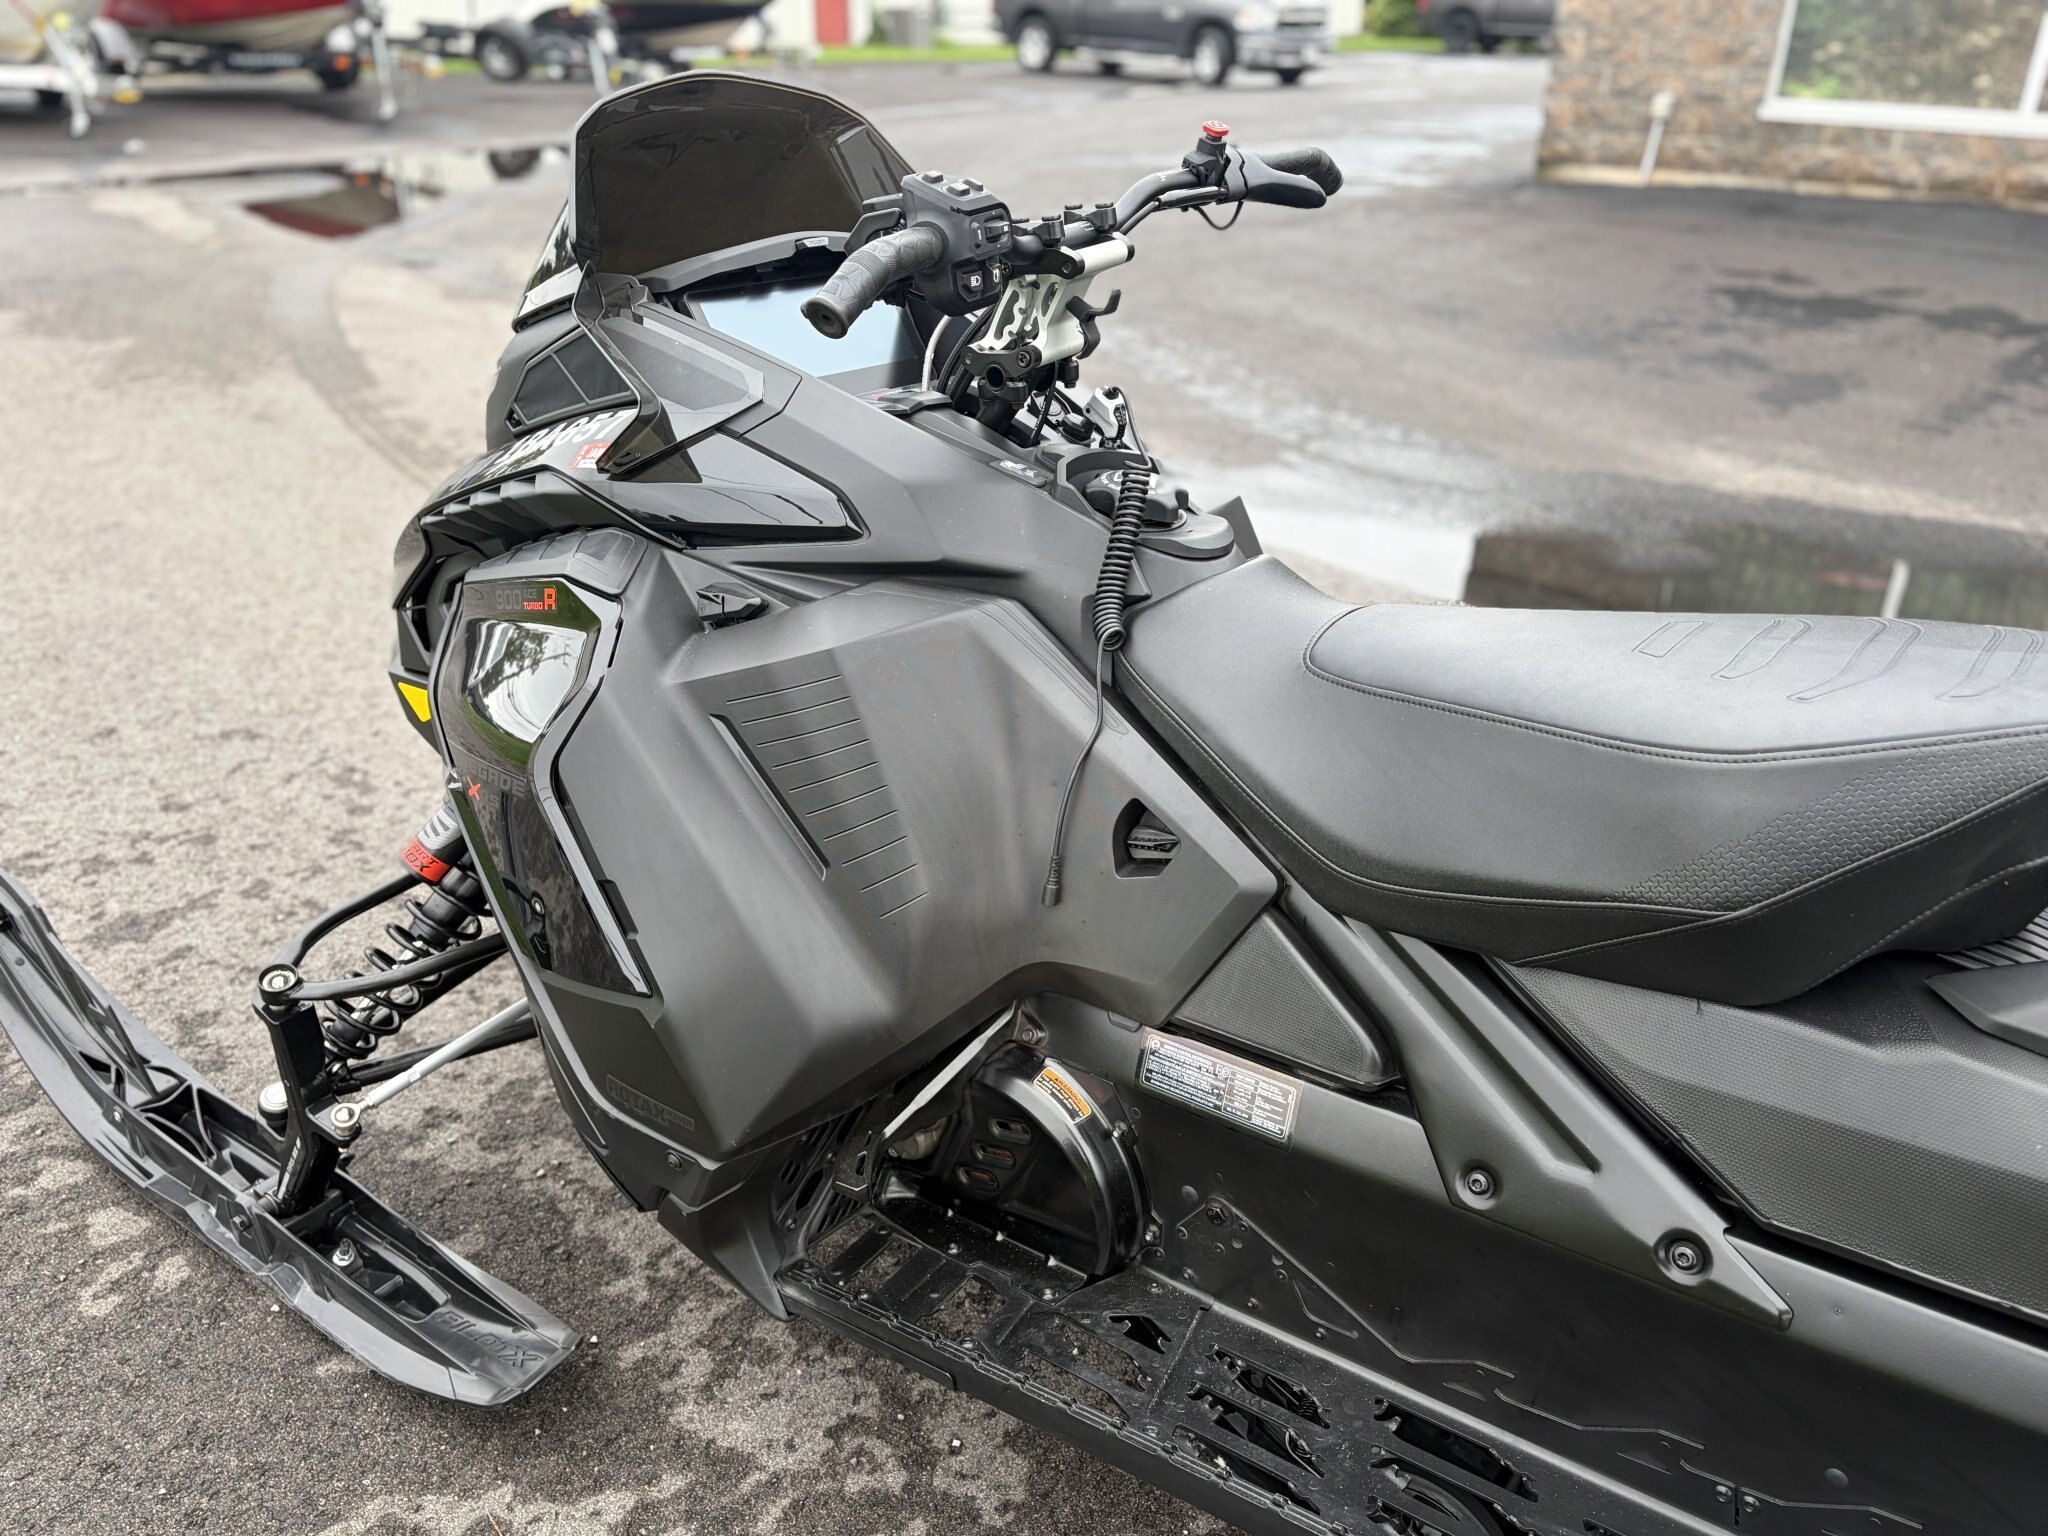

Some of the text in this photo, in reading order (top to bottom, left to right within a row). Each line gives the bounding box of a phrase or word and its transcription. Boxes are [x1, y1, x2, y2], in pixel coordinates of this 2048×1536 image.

[495, 588, 538, 611] 900 ACE
[523, 588, 556, 610] TURBO R
[1057, 1079, 1082, 1104] WARNING
